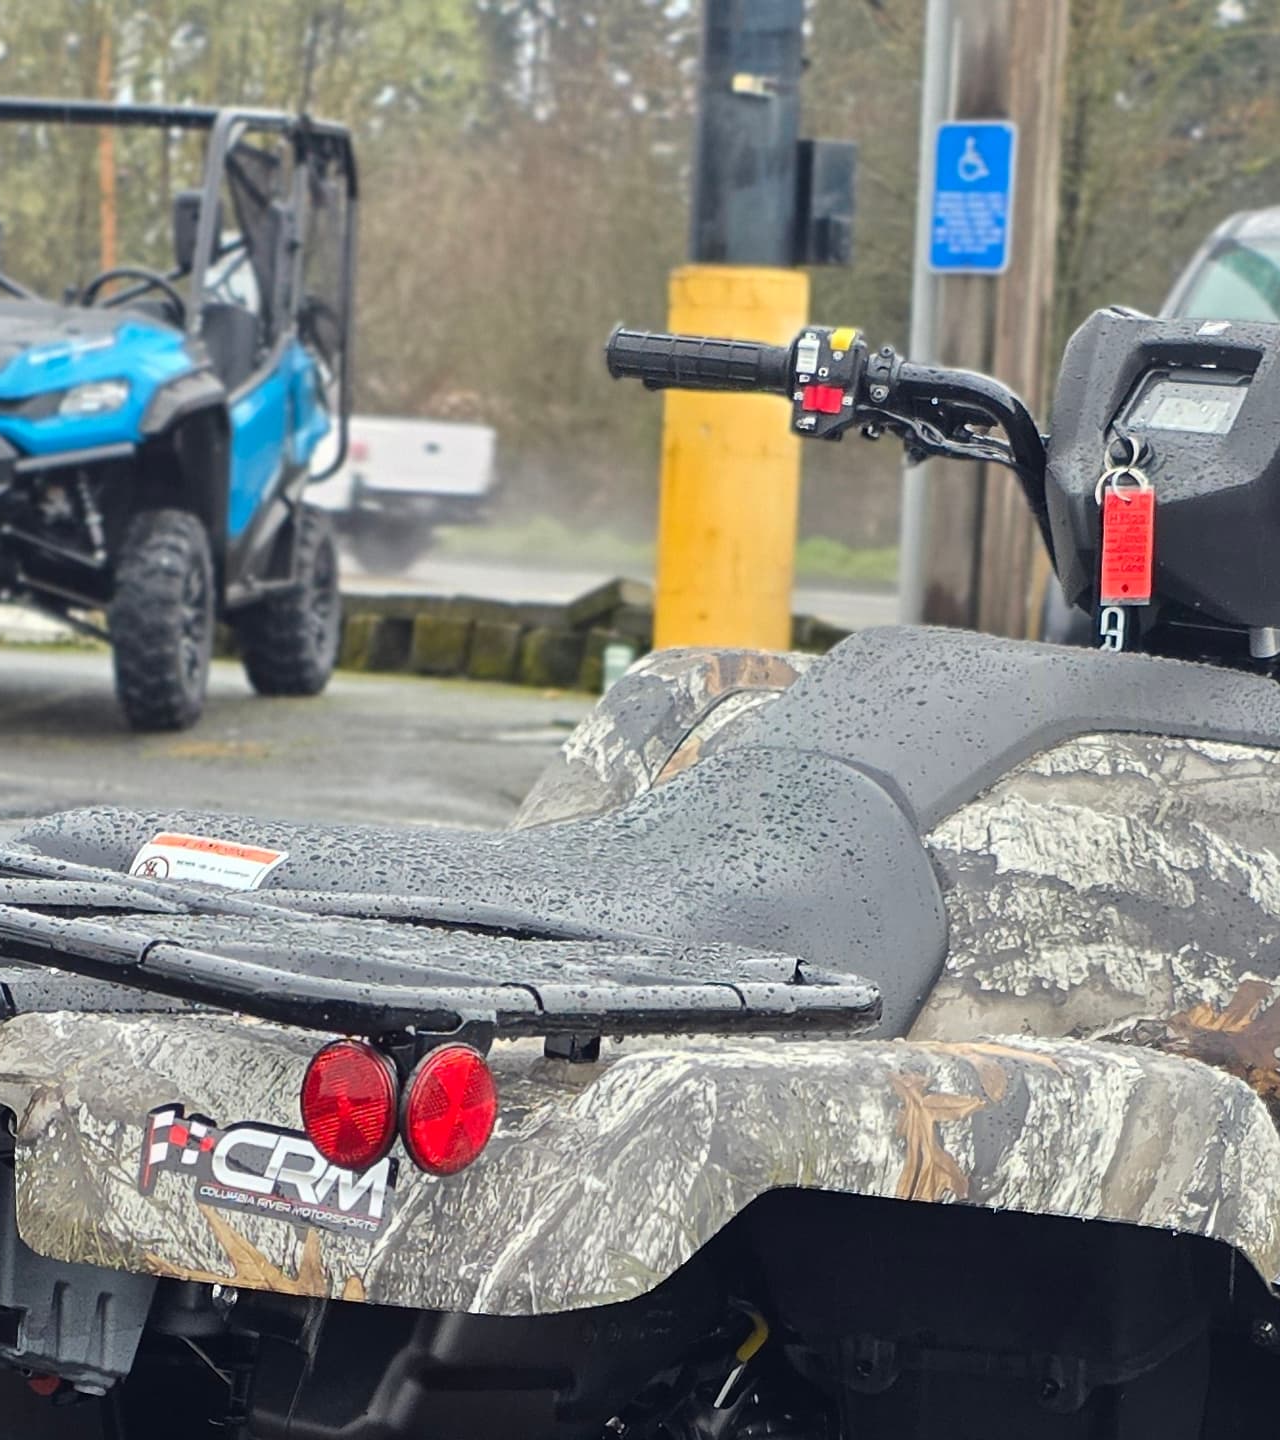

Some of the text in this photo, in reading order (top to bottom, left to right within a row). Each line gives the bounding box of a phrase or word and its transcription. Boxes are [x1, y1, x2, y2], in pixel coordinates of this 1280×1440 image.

[212, 1128, 390, 1218] CRM
[199, 1185, 379, 1232] COLUMBIA RIVER MOTORSPORTS
